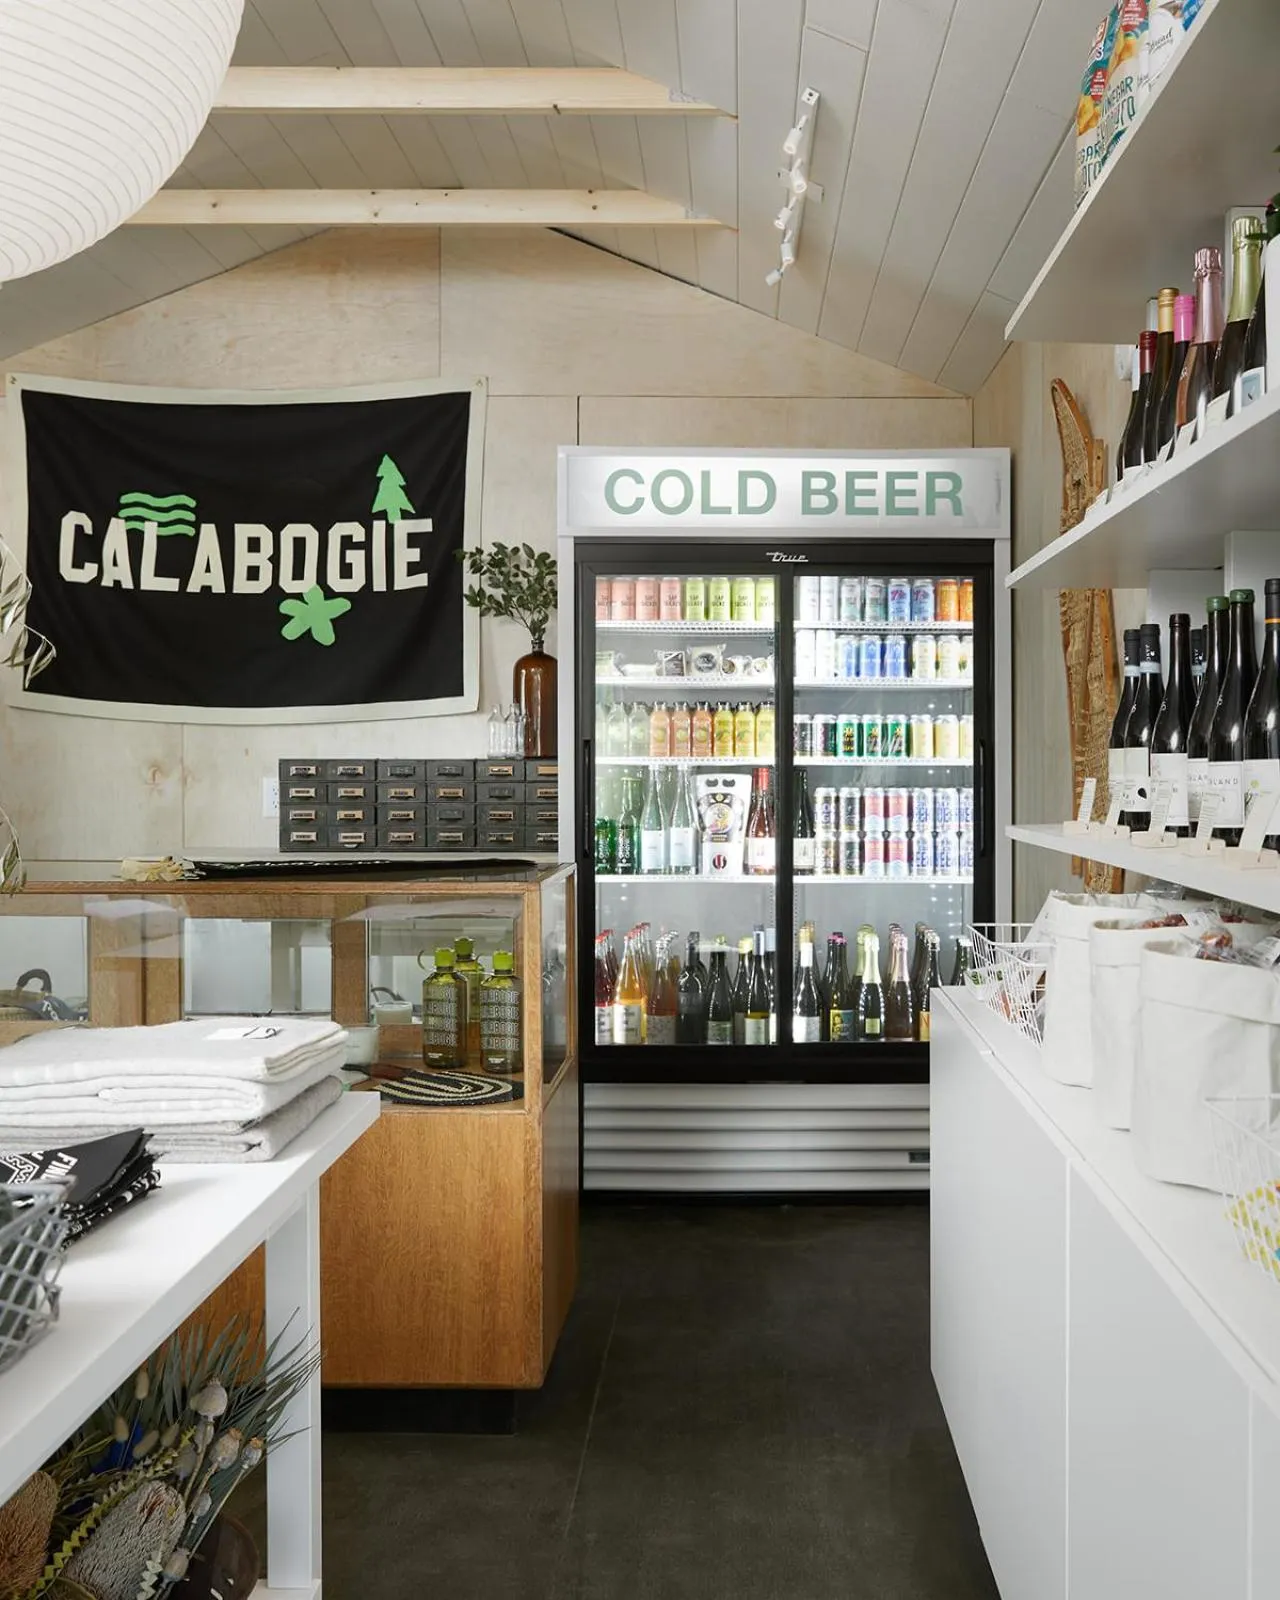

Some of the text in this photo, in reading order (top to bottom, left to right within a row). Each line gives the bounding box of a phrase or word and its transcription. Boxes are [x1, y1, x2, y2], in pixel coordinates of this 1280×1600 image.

[604, 468, 964, 516] COLD BEER
[59, 510, 433, 595] CALABOGIE
[766, 551, 809, 562] True
